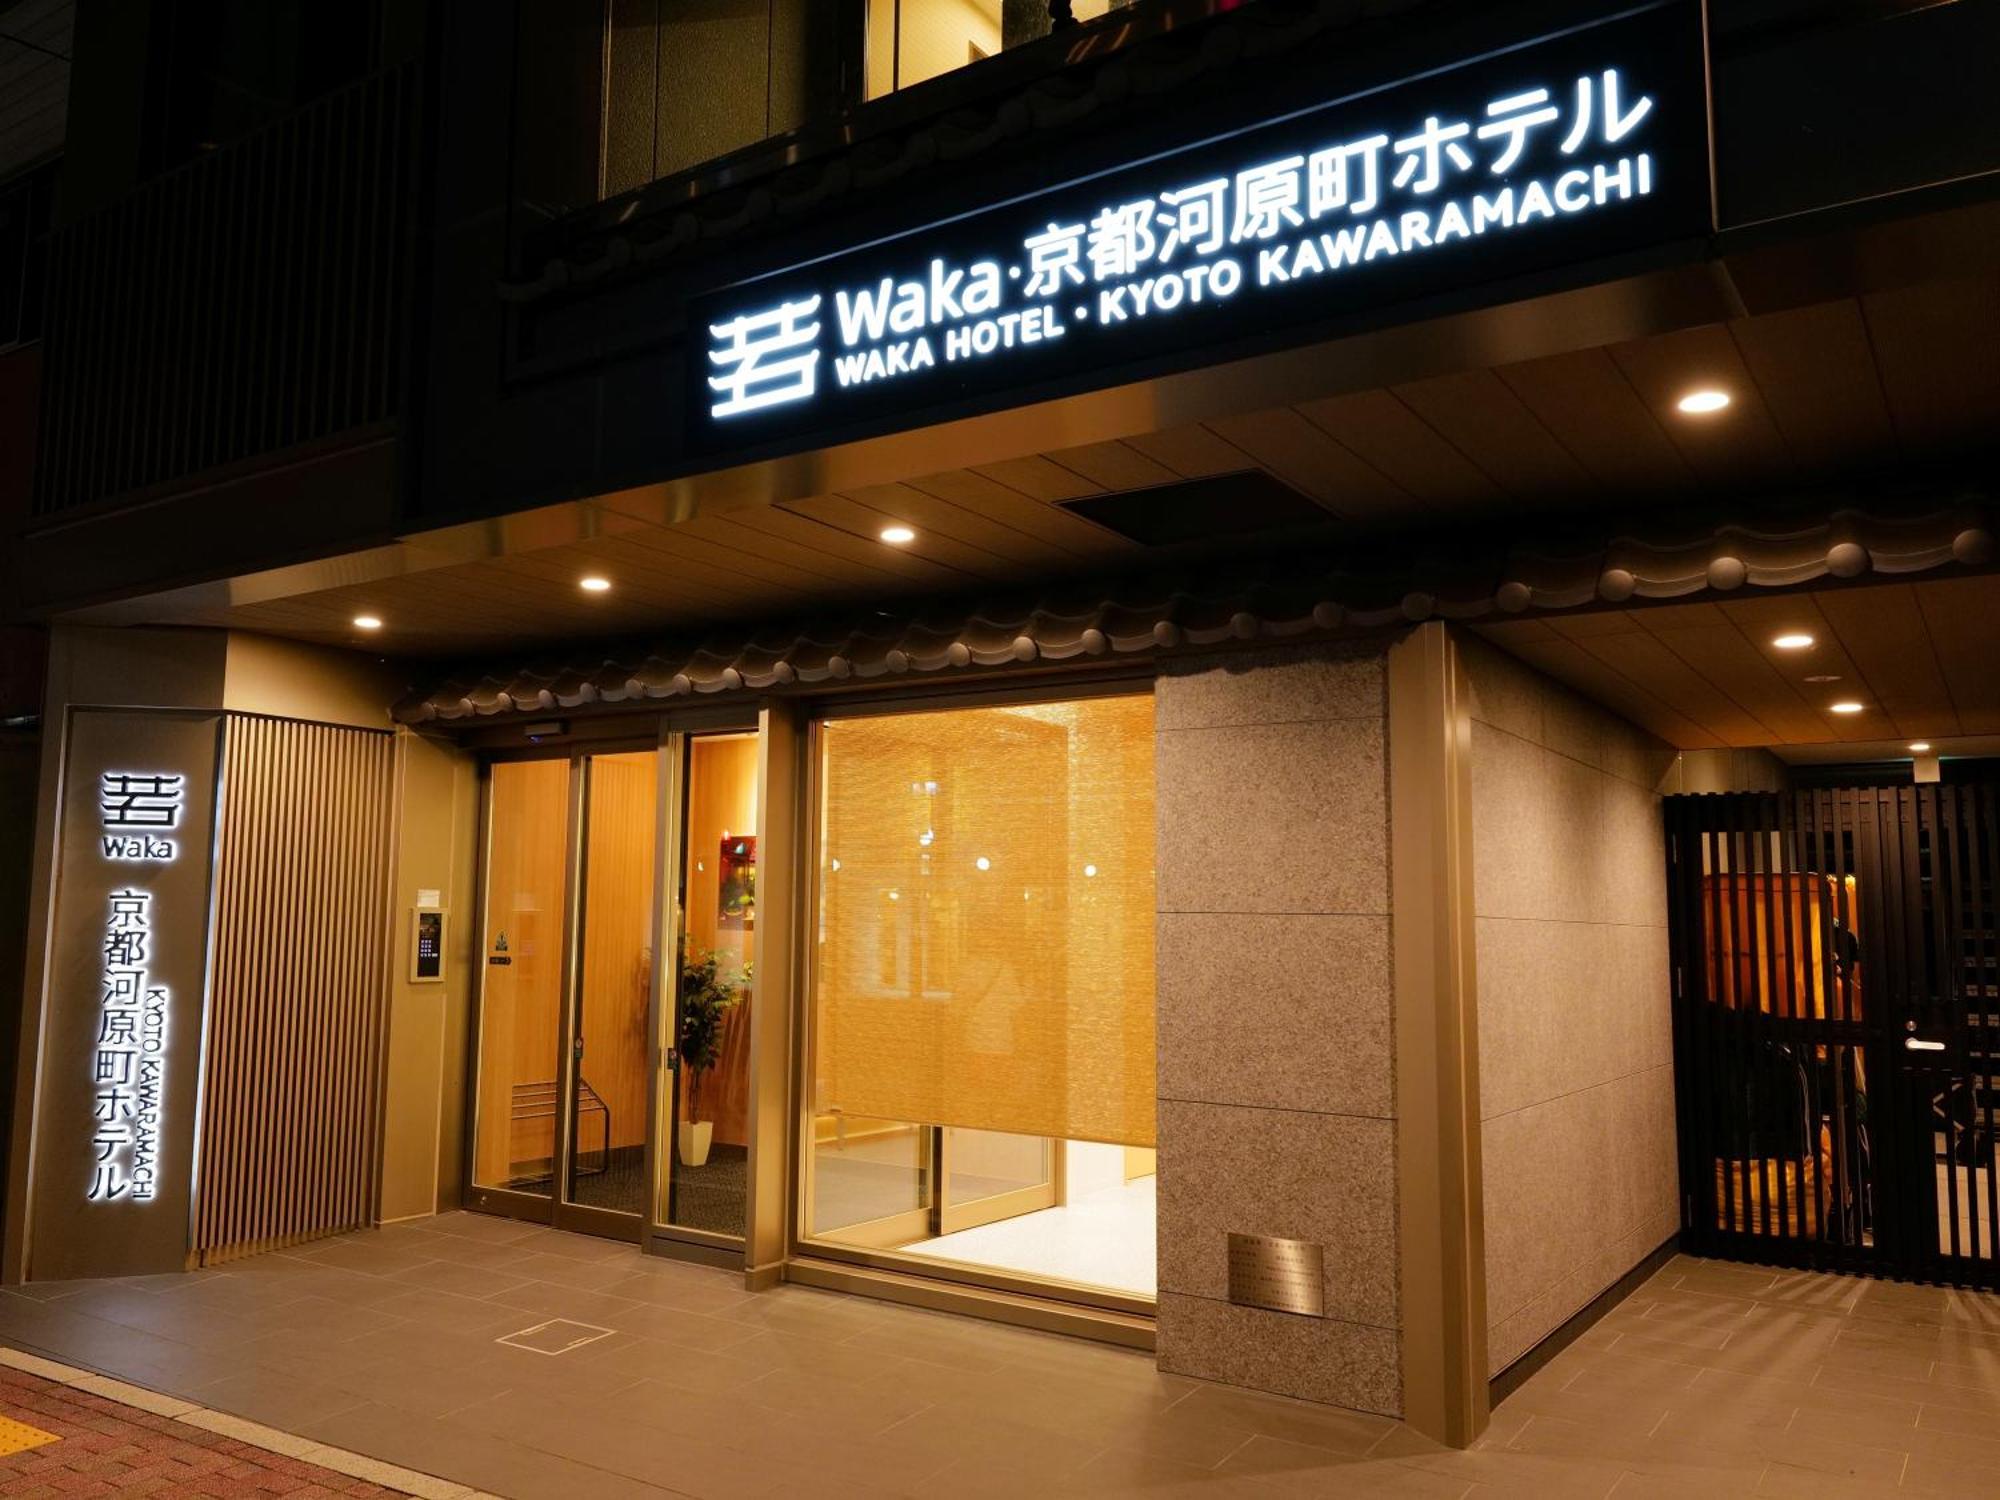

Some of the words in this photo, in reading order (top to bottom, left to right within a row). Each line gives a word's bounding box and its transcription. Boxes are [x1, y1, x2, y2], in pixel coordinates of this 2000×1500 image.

[834, 337, 935, 387] WAKA
[946, 305, 1065, 361] HOTEL
[1100, 259, 1241, 324] KYOTO
[1259, 153, 1650, 286] KAWARAMACHI
[102, 834, 174, 859] Waka
[87, 889, 149, 1200] 京都河原町ホテル
[141, 988, 167, 1054] KYOTO
[131, 1059, 162, 1199] KAWARAMACHI
